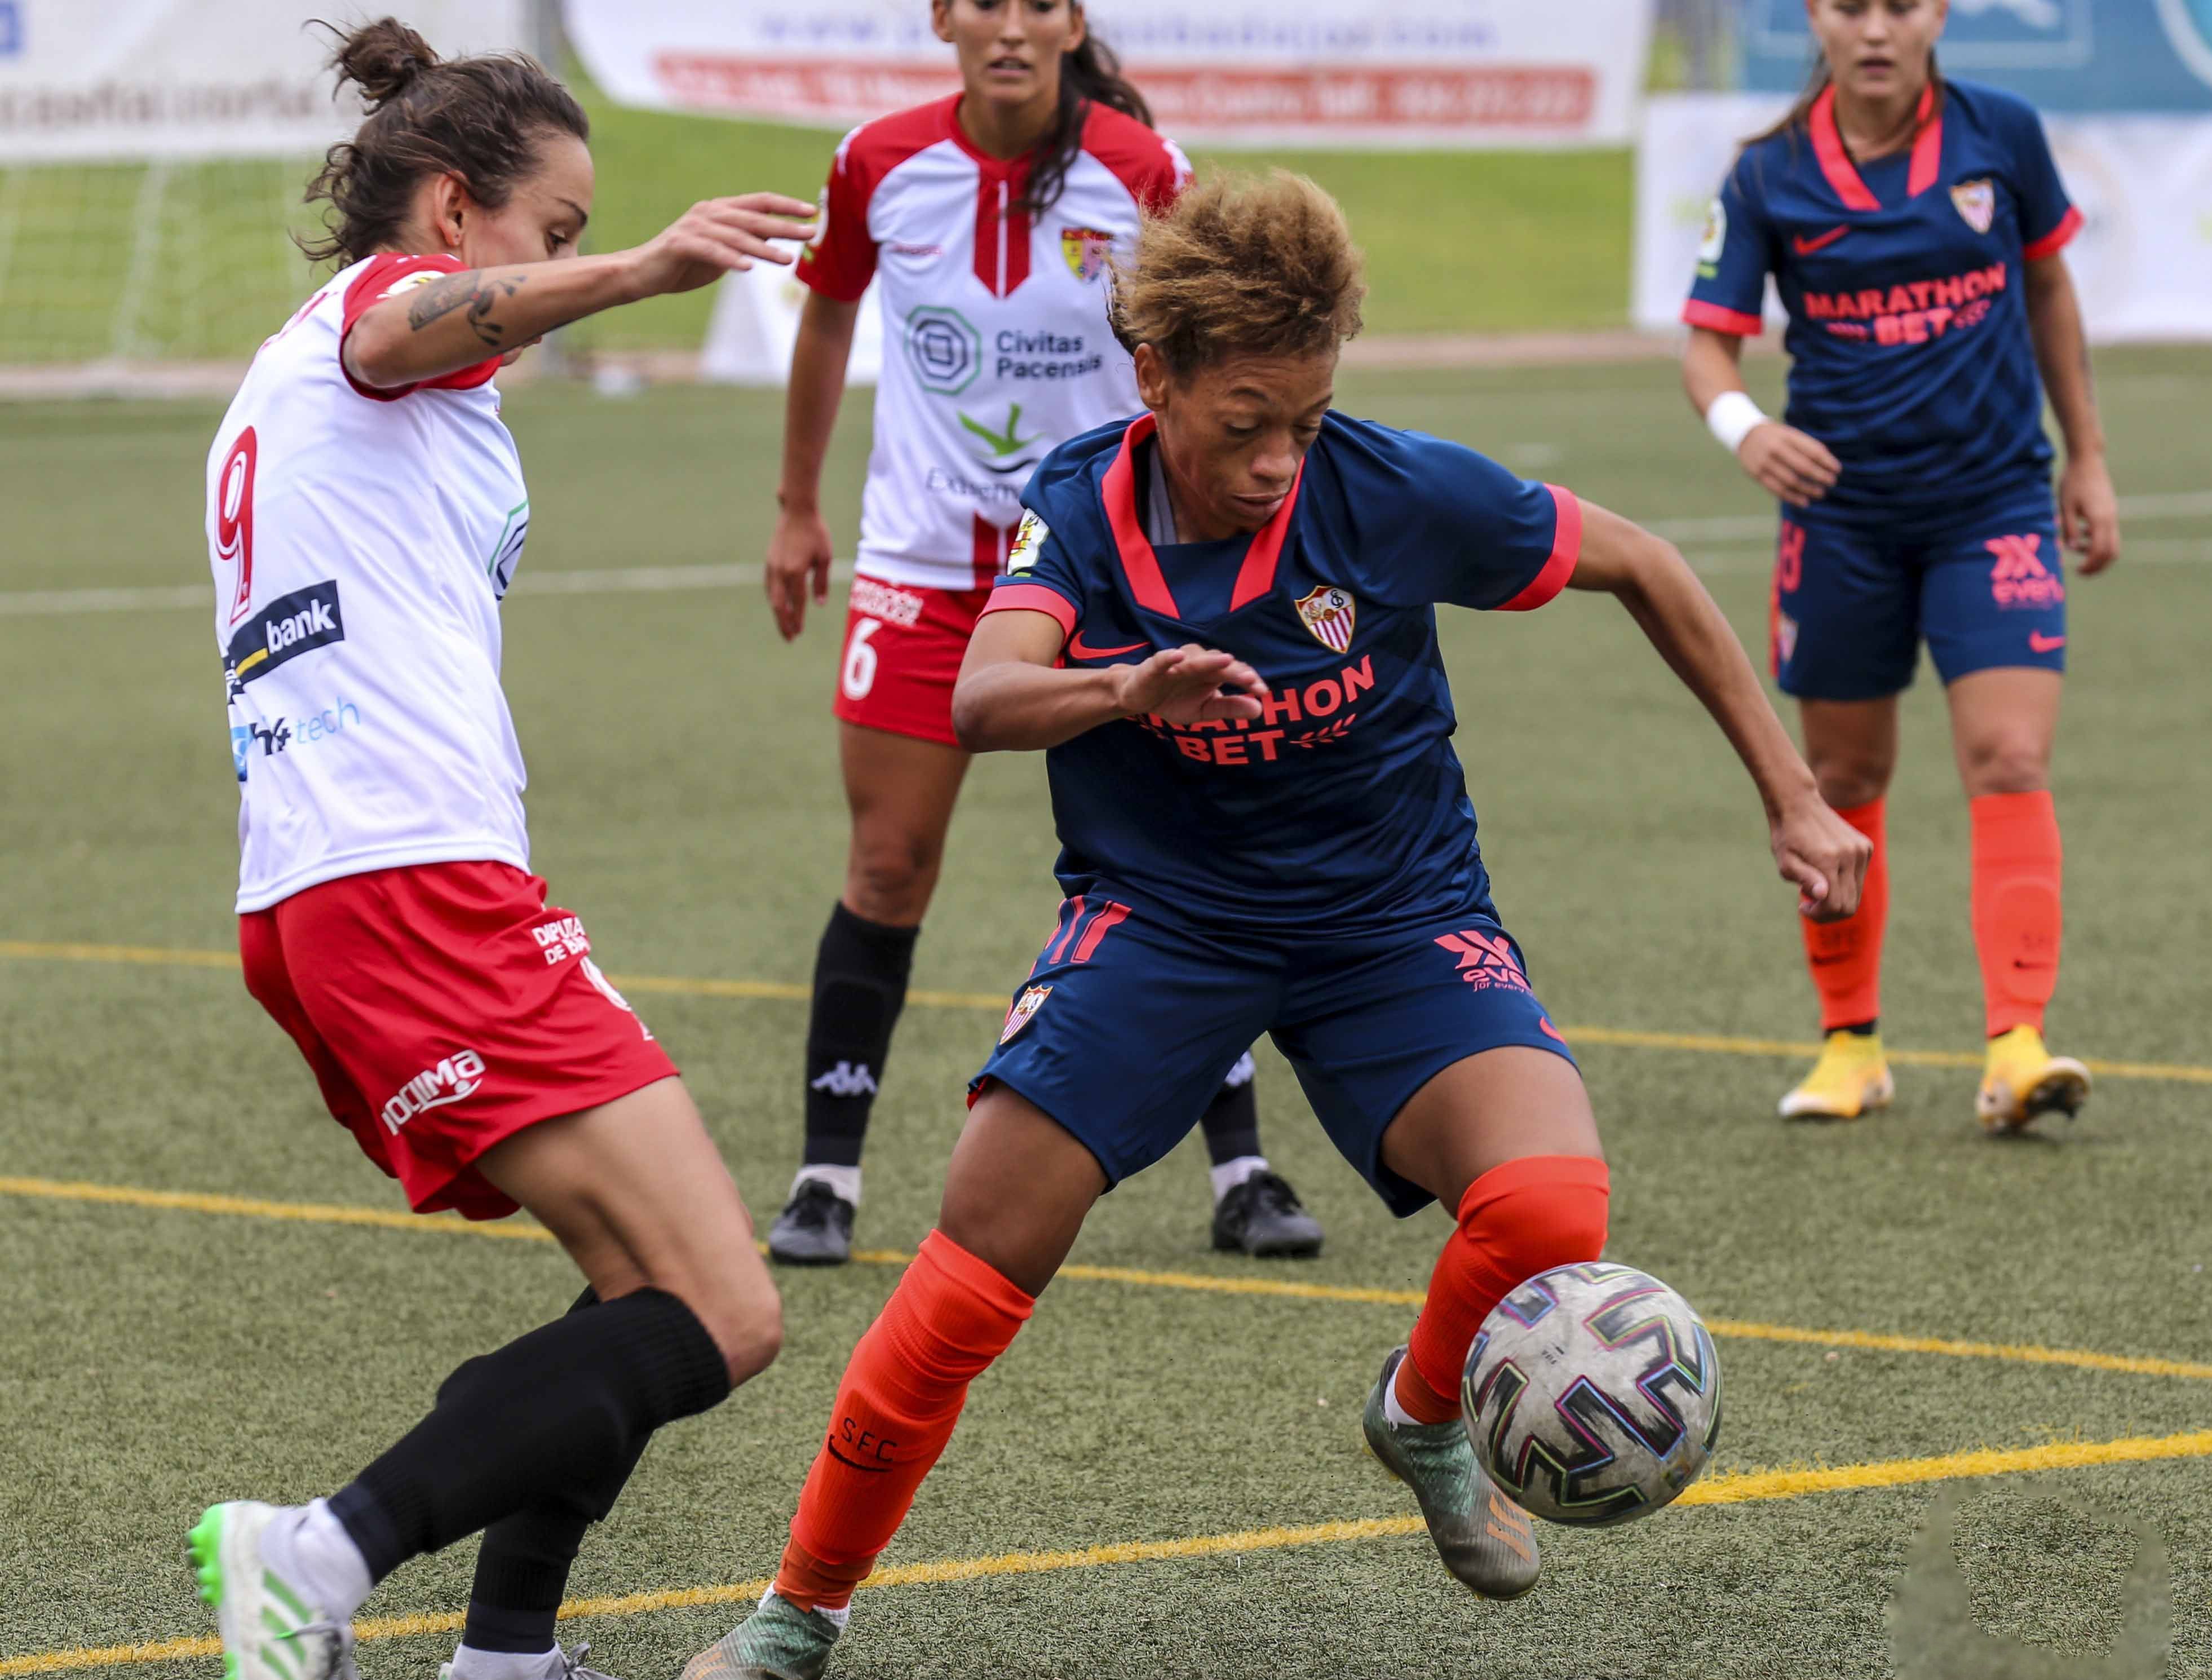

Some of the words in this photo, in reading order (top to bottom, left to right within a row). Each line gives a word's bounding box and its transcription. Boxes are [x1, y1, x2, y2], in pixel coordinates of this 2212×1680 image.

[1803, 262, 2007, 319] MARATHON
[997, 329, 1084, 353] Civitas
[1874, 307, 1953, 346] BET
[997, 354, 1103, 379] Pacensis
[215, 425, 258, 627] 9
[266, 599, 337, 655] bank
[843, 616, 883, 701] 6
[297, 696, 360, 744] tech
[1174, 730, 1285, 765] BET
[544, 944, 567, 966] DE
[842, 1417, 898, 1462] SFC
